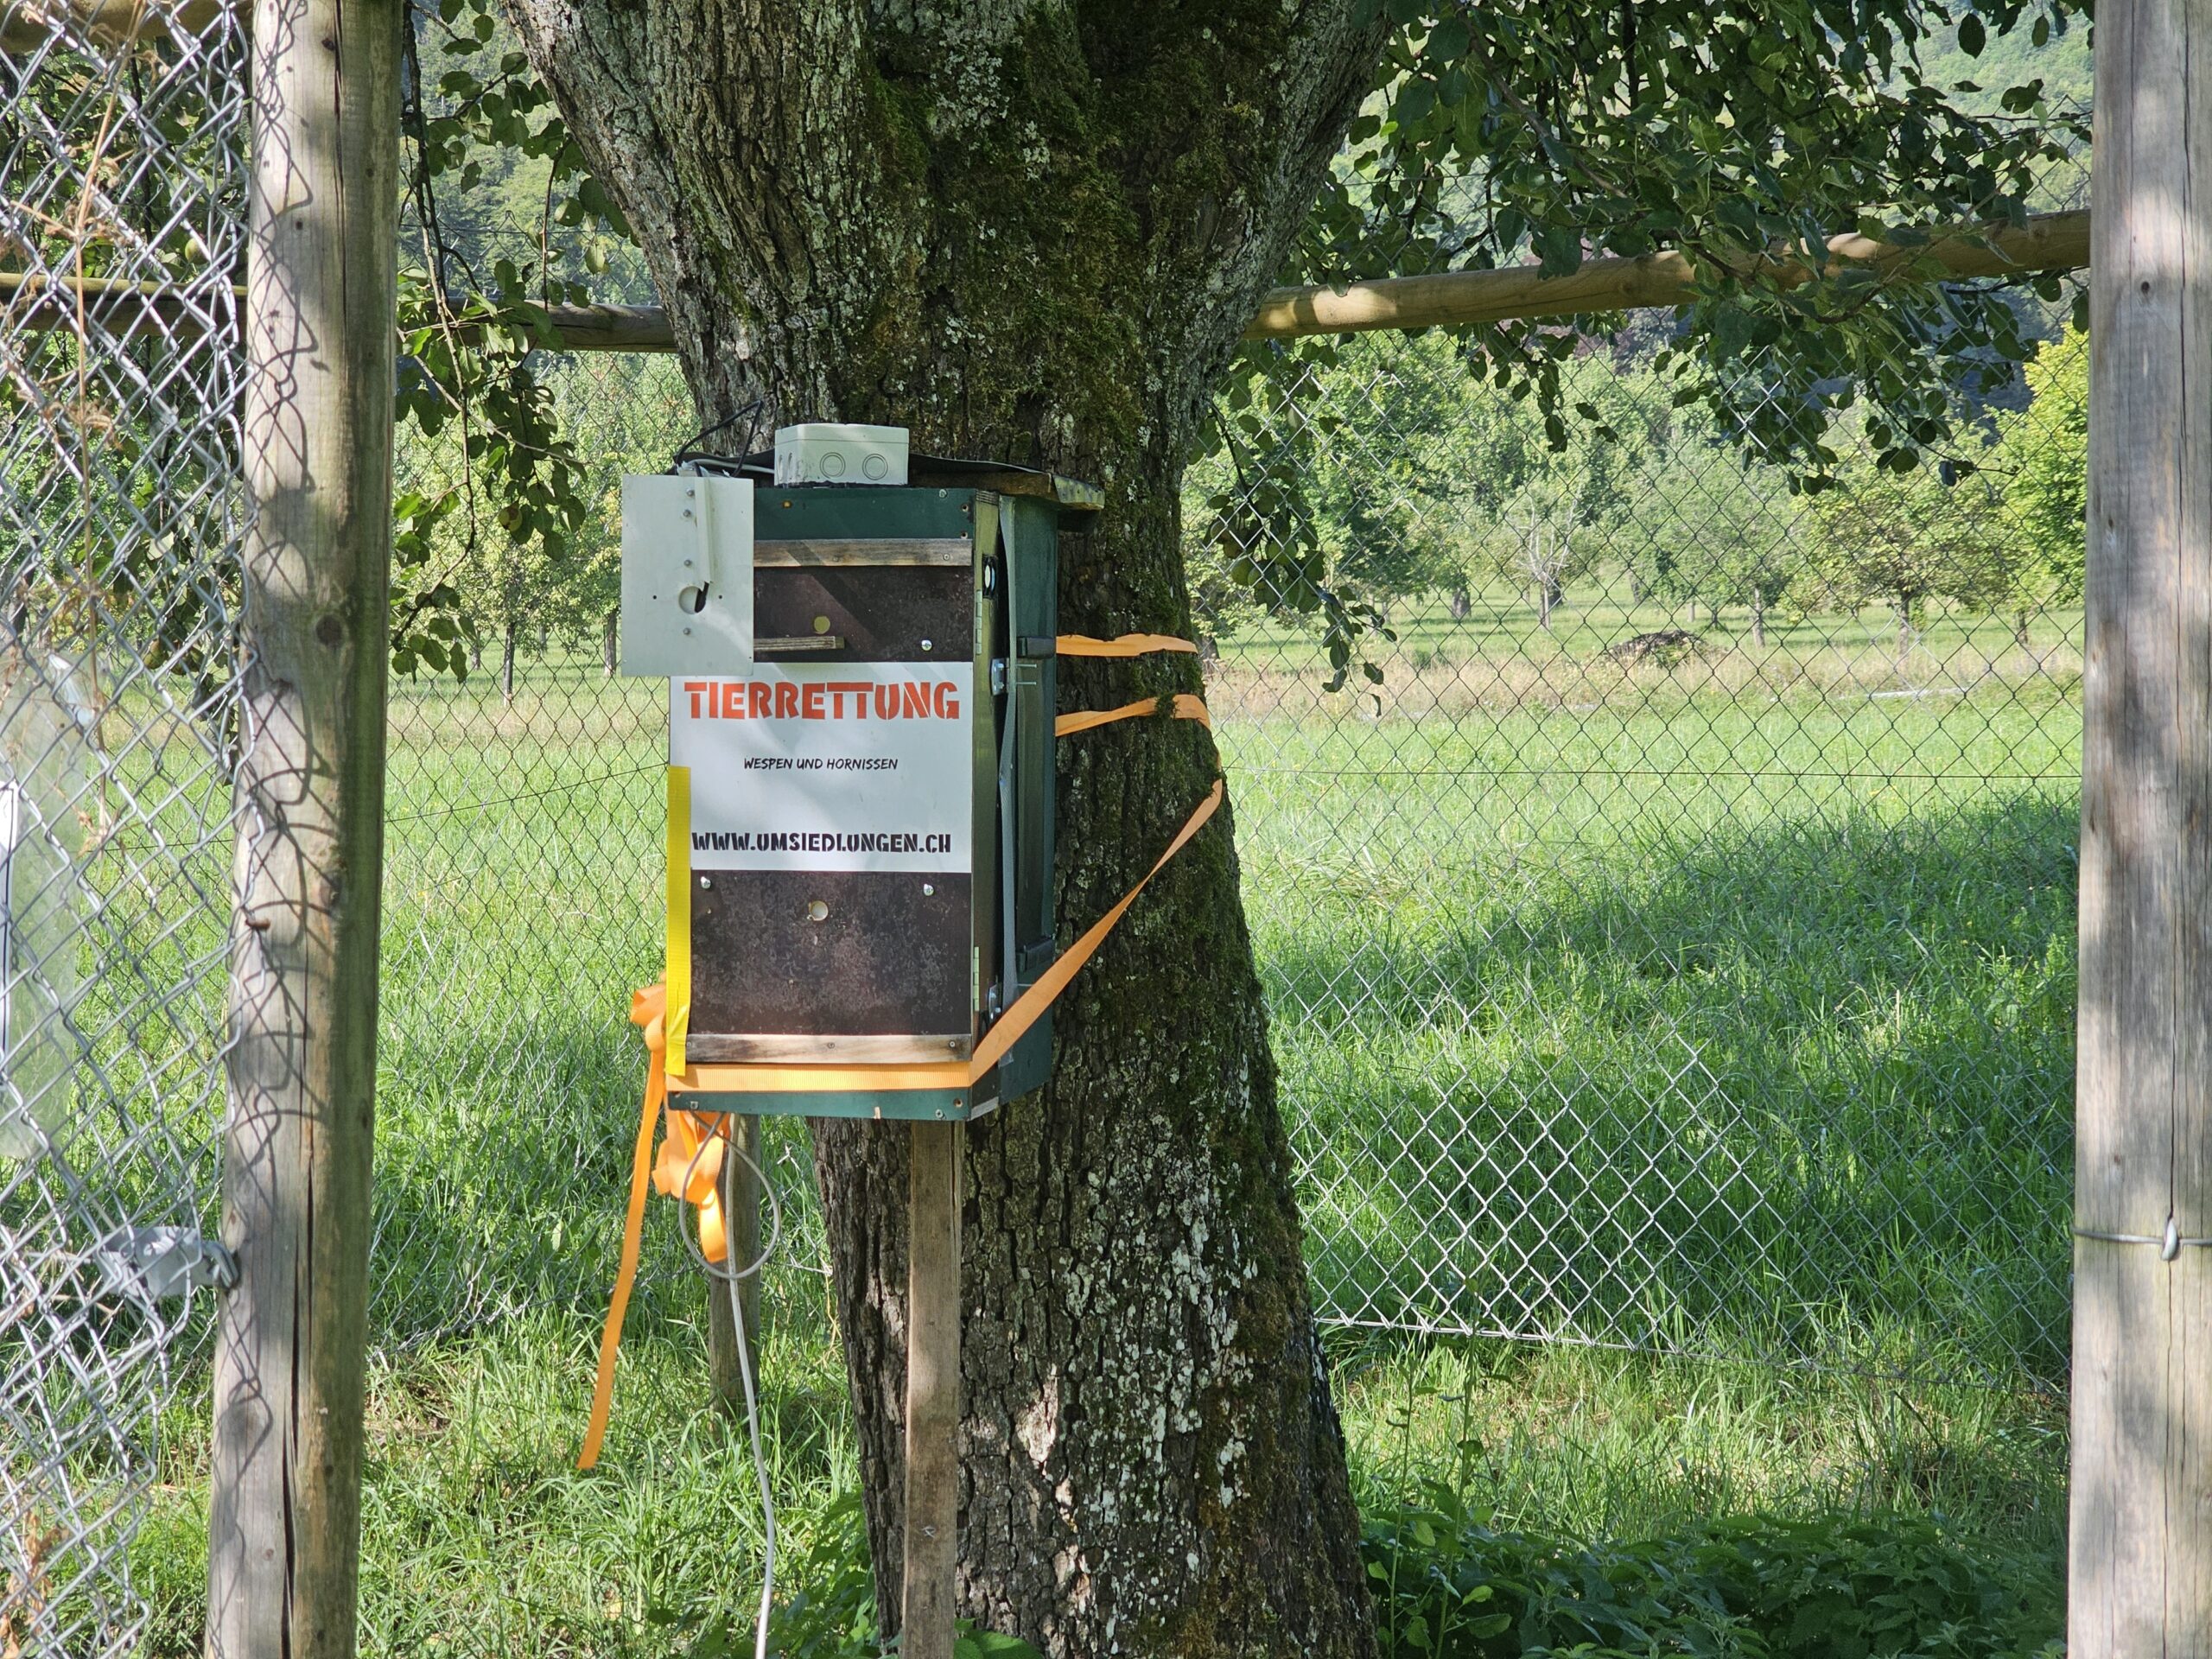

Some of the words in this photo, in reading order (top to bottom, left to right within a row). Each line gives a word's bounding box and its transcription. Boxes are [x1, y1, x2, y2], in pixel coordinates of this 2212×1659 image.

[683, 681, 960, 720] TIERRETTUNG
[743, 756, 794, 771] WESPEN
[796, 757, 823, 770] UND
[826, 757, 899, 771] HORNISSEN
[691, 831, 951, 853] WWW.UMSIEDLUNGEN.CH
